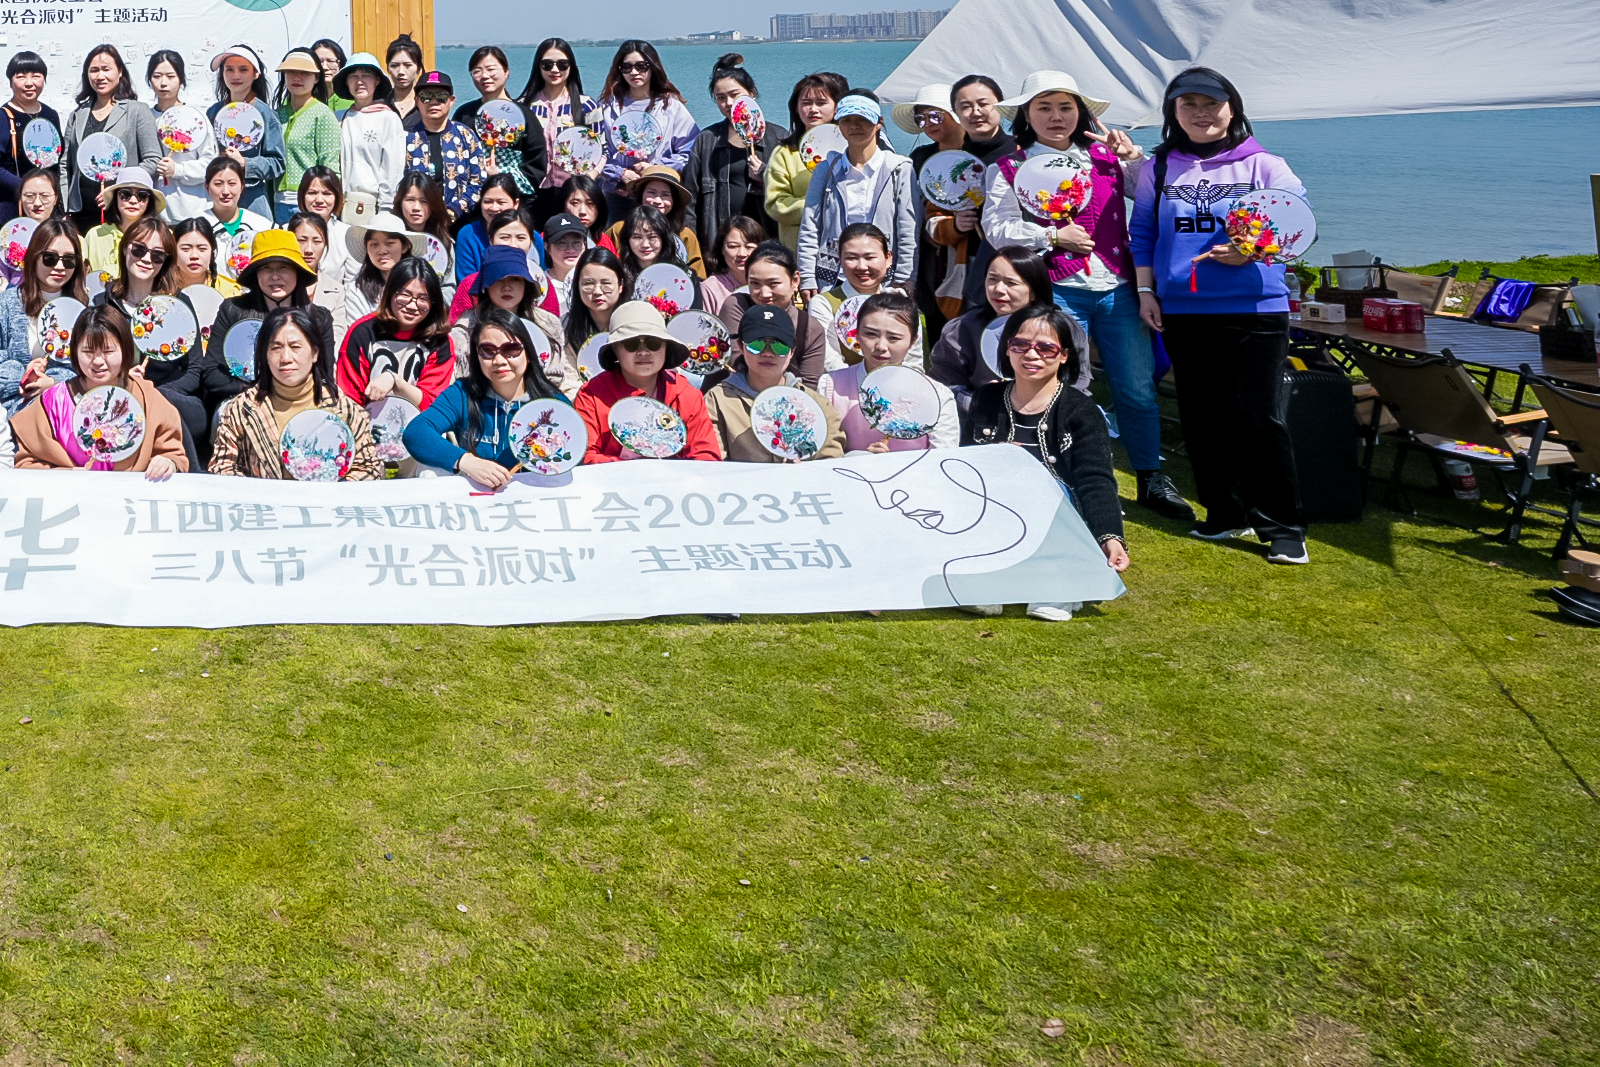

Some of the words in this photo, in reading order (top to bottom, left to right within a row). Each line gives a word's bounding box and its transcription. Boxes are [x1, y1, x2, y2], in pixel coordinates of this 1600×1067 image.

[123, 491, 843, 536] 江西建工集团机关工会2023年
